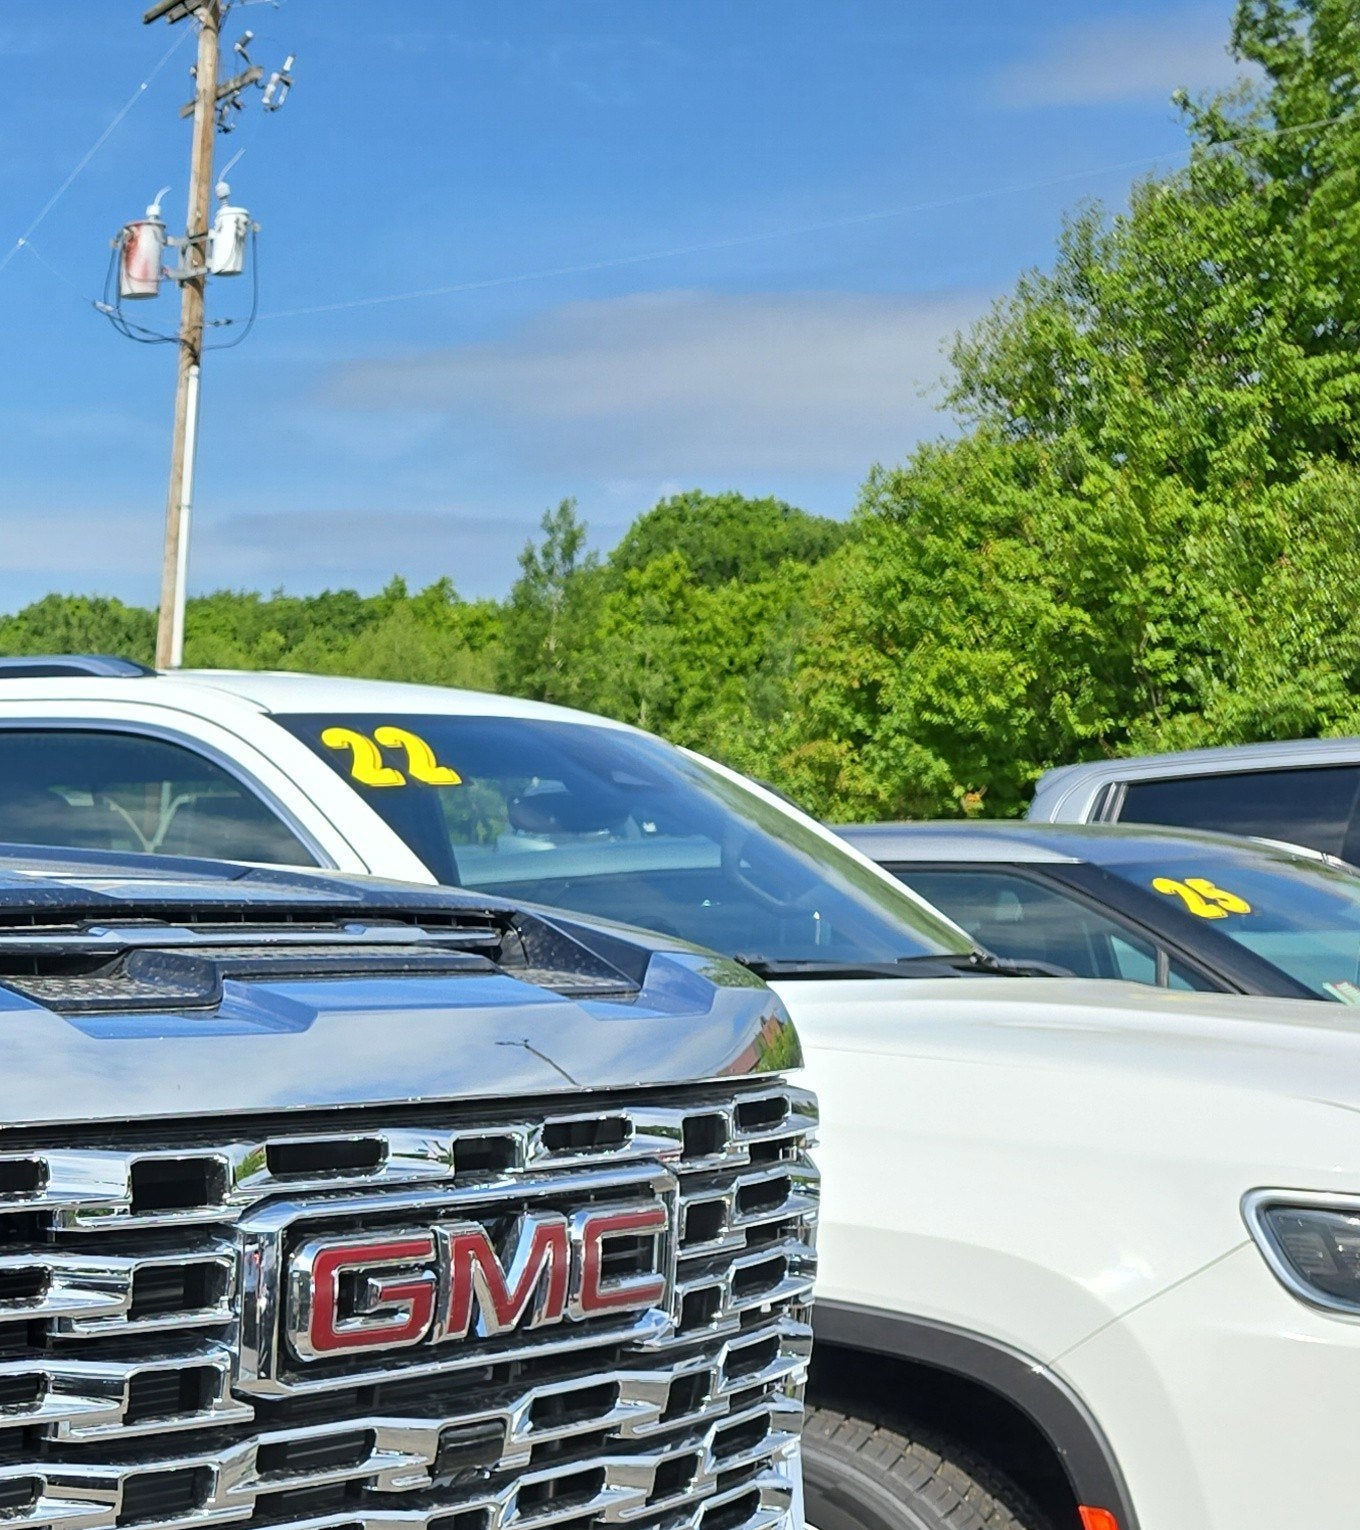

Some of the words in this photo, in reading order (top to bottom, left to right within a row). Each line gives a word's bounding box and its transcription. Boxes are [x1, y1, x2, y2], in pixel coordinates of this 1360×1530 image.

[321, 726, 463, 787] 22
[1152, 877, 1251, 919] 25
[288, 1199, 668, 1362] GMC
